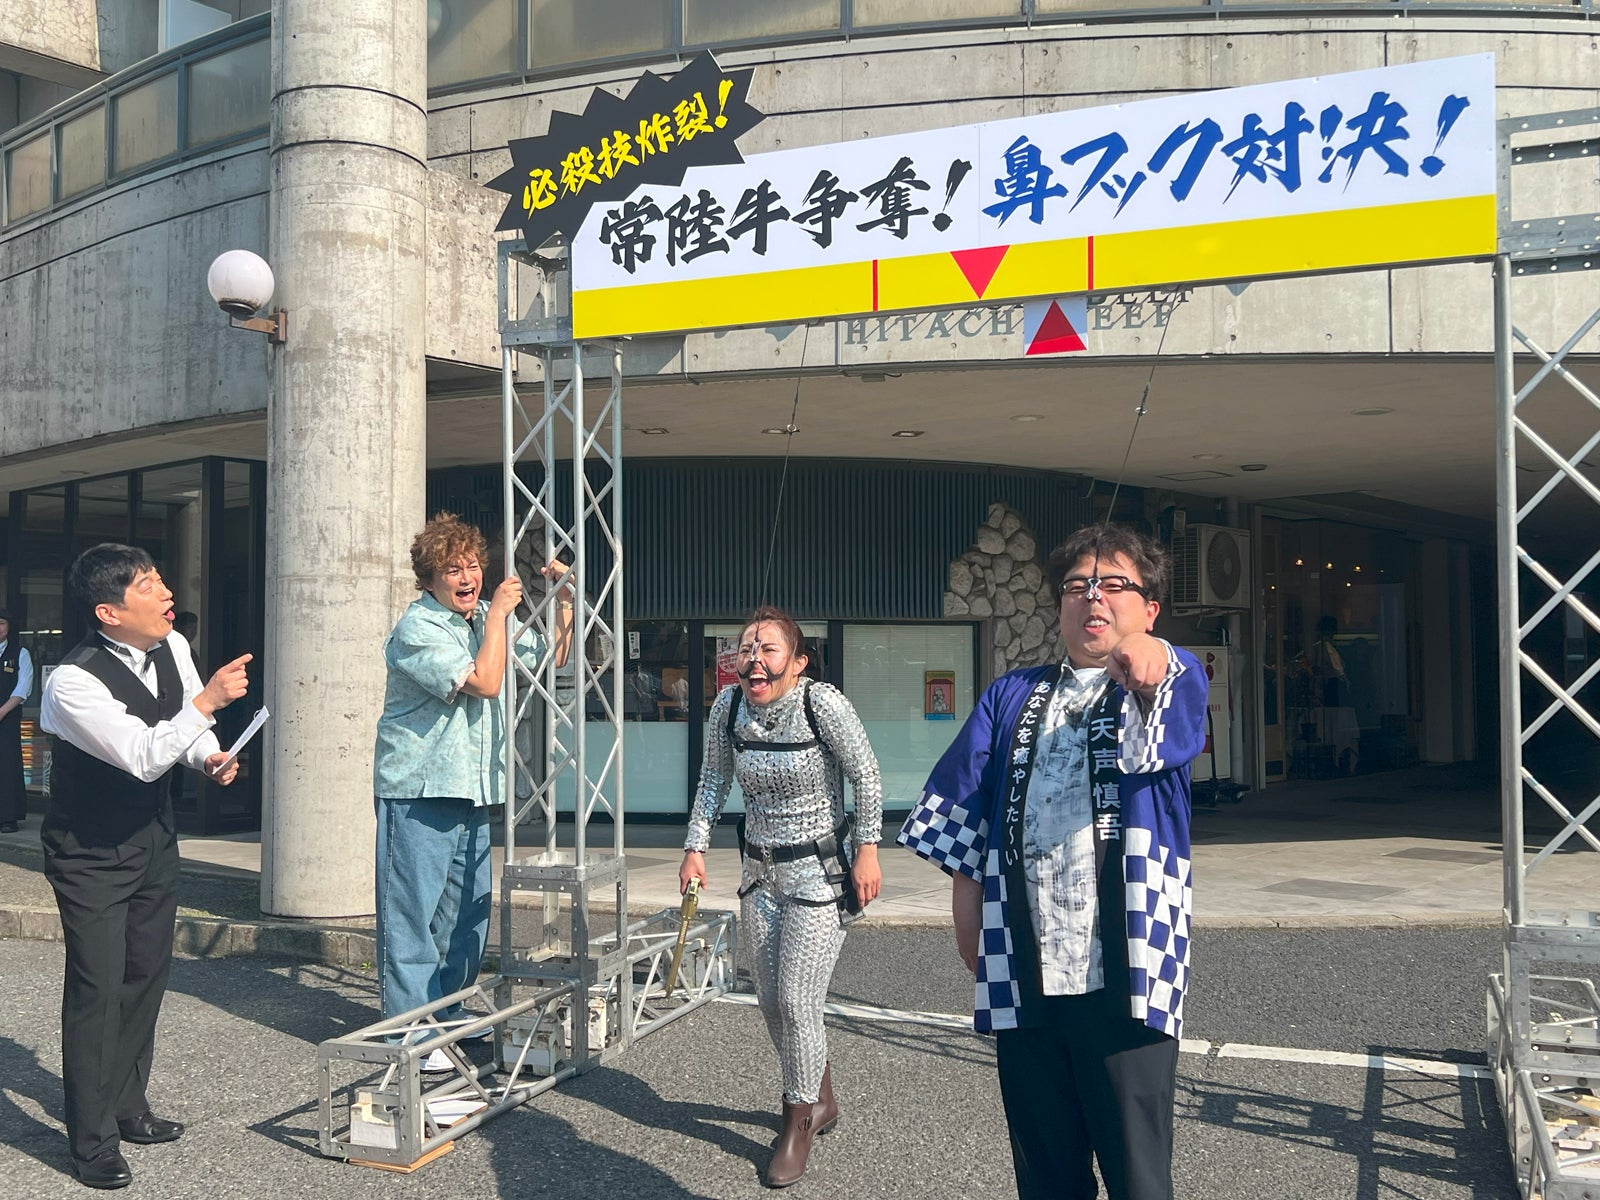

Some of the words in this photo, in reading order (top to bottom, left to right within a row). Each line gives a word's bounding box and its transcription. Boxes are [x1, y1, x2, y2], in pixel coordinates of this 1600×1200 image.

[522, 79, 734, 220] 必殺技炸裂!
[599, 156, 972, 275] 常陸牛争奪!
[981, 91, 1469, 230] 鼻フック対決!
[845, 307, 1025, 345] HITACH
